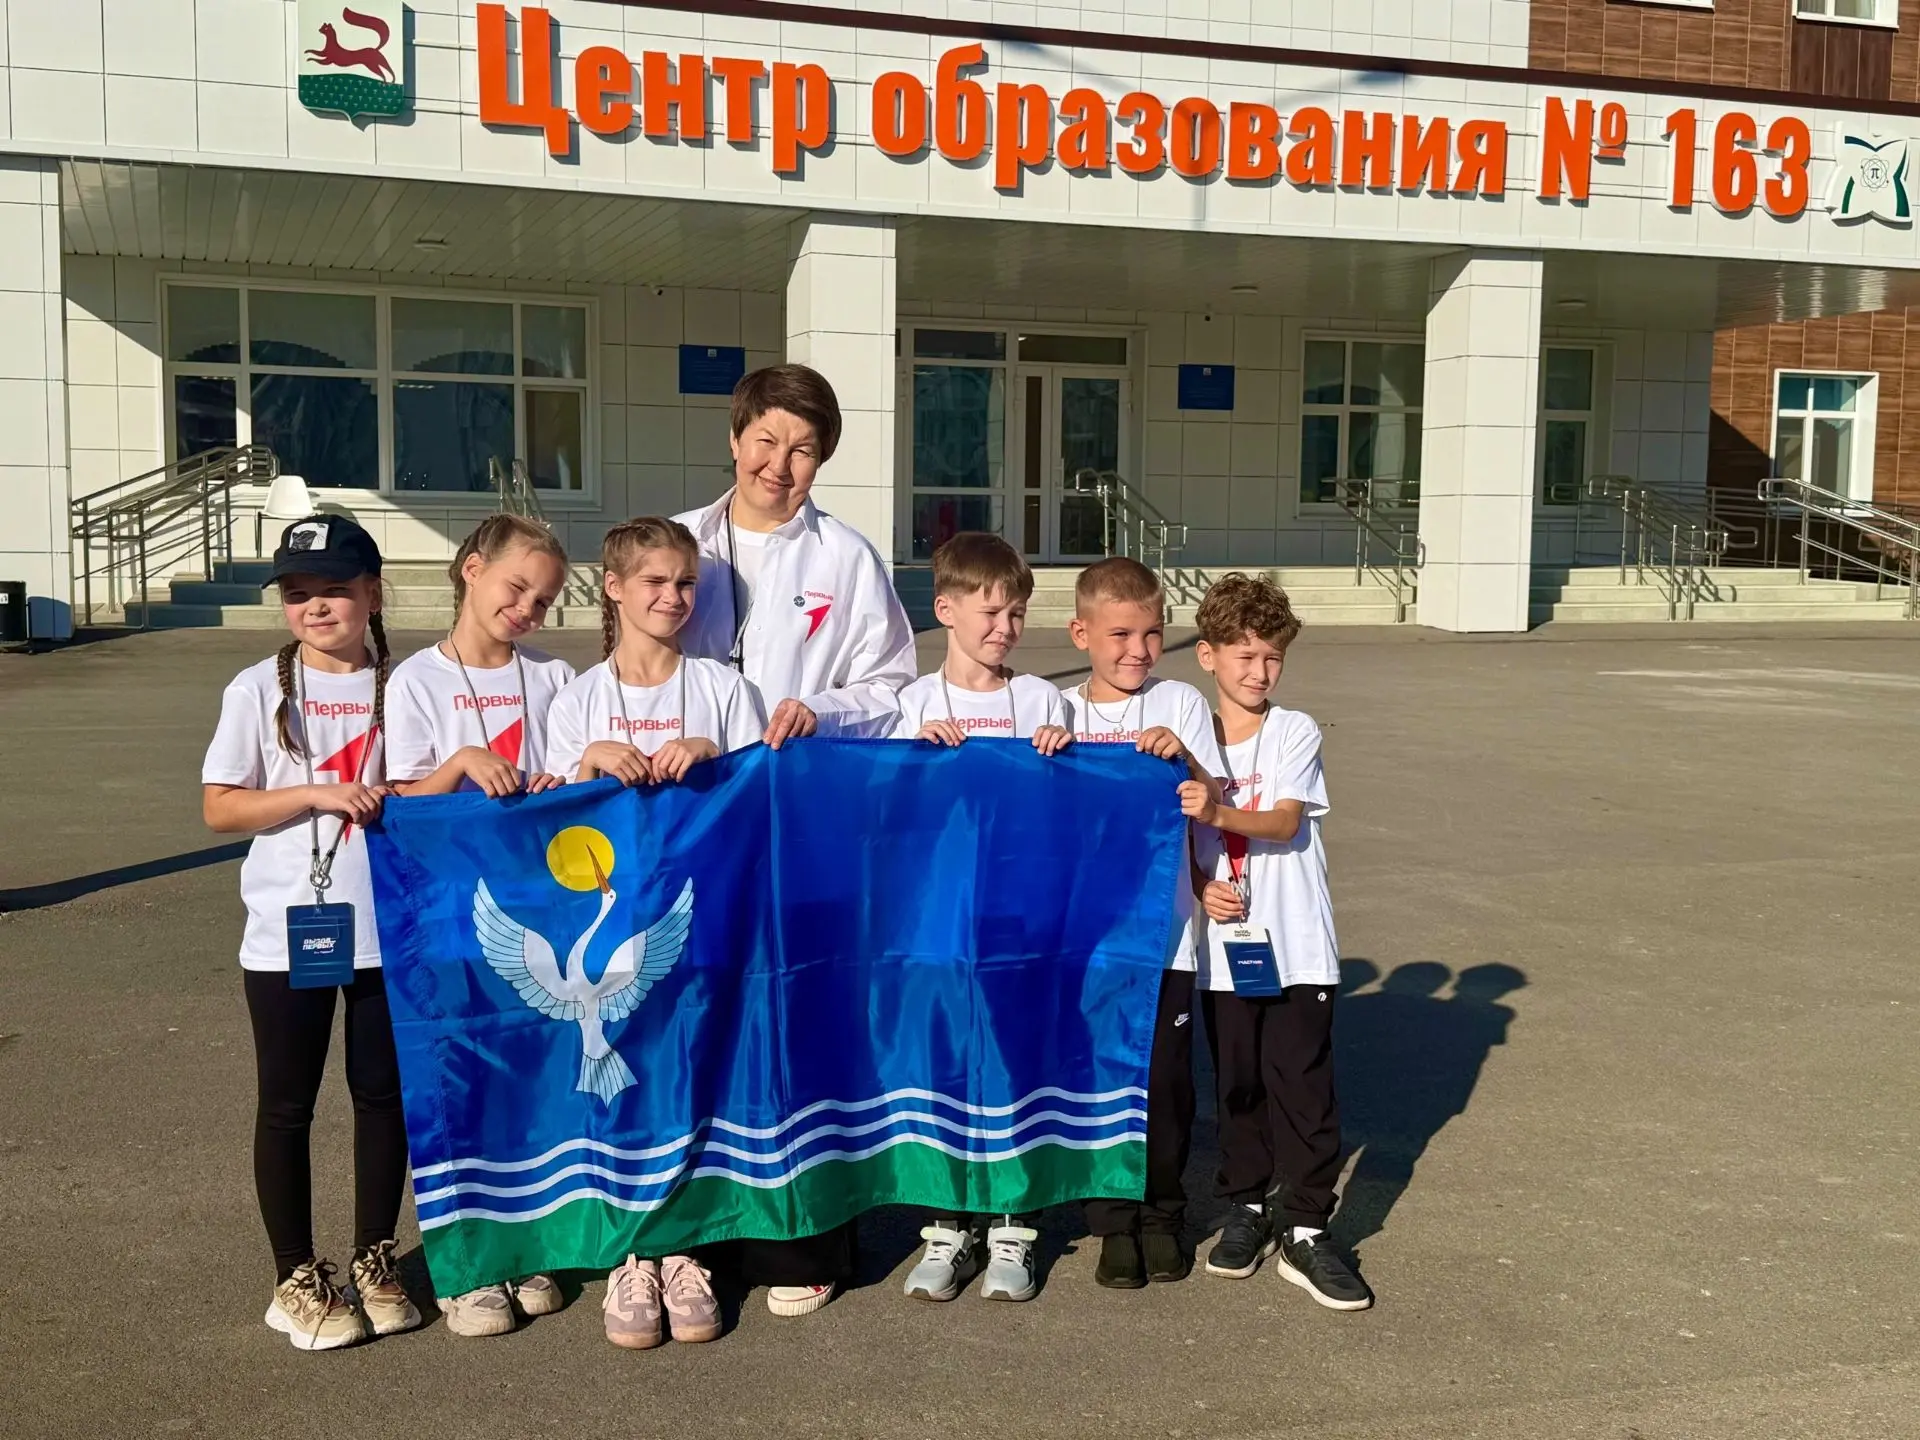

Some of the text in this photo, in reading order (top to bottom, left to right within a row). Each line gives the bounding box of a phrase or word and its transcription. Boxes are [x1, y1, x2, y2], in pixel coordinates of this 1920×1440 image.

[477, 3, 1812, 217] Центр образования № 163
[305, 700, 373, 720] Первы
[608, 716, 681, 735] Первые
